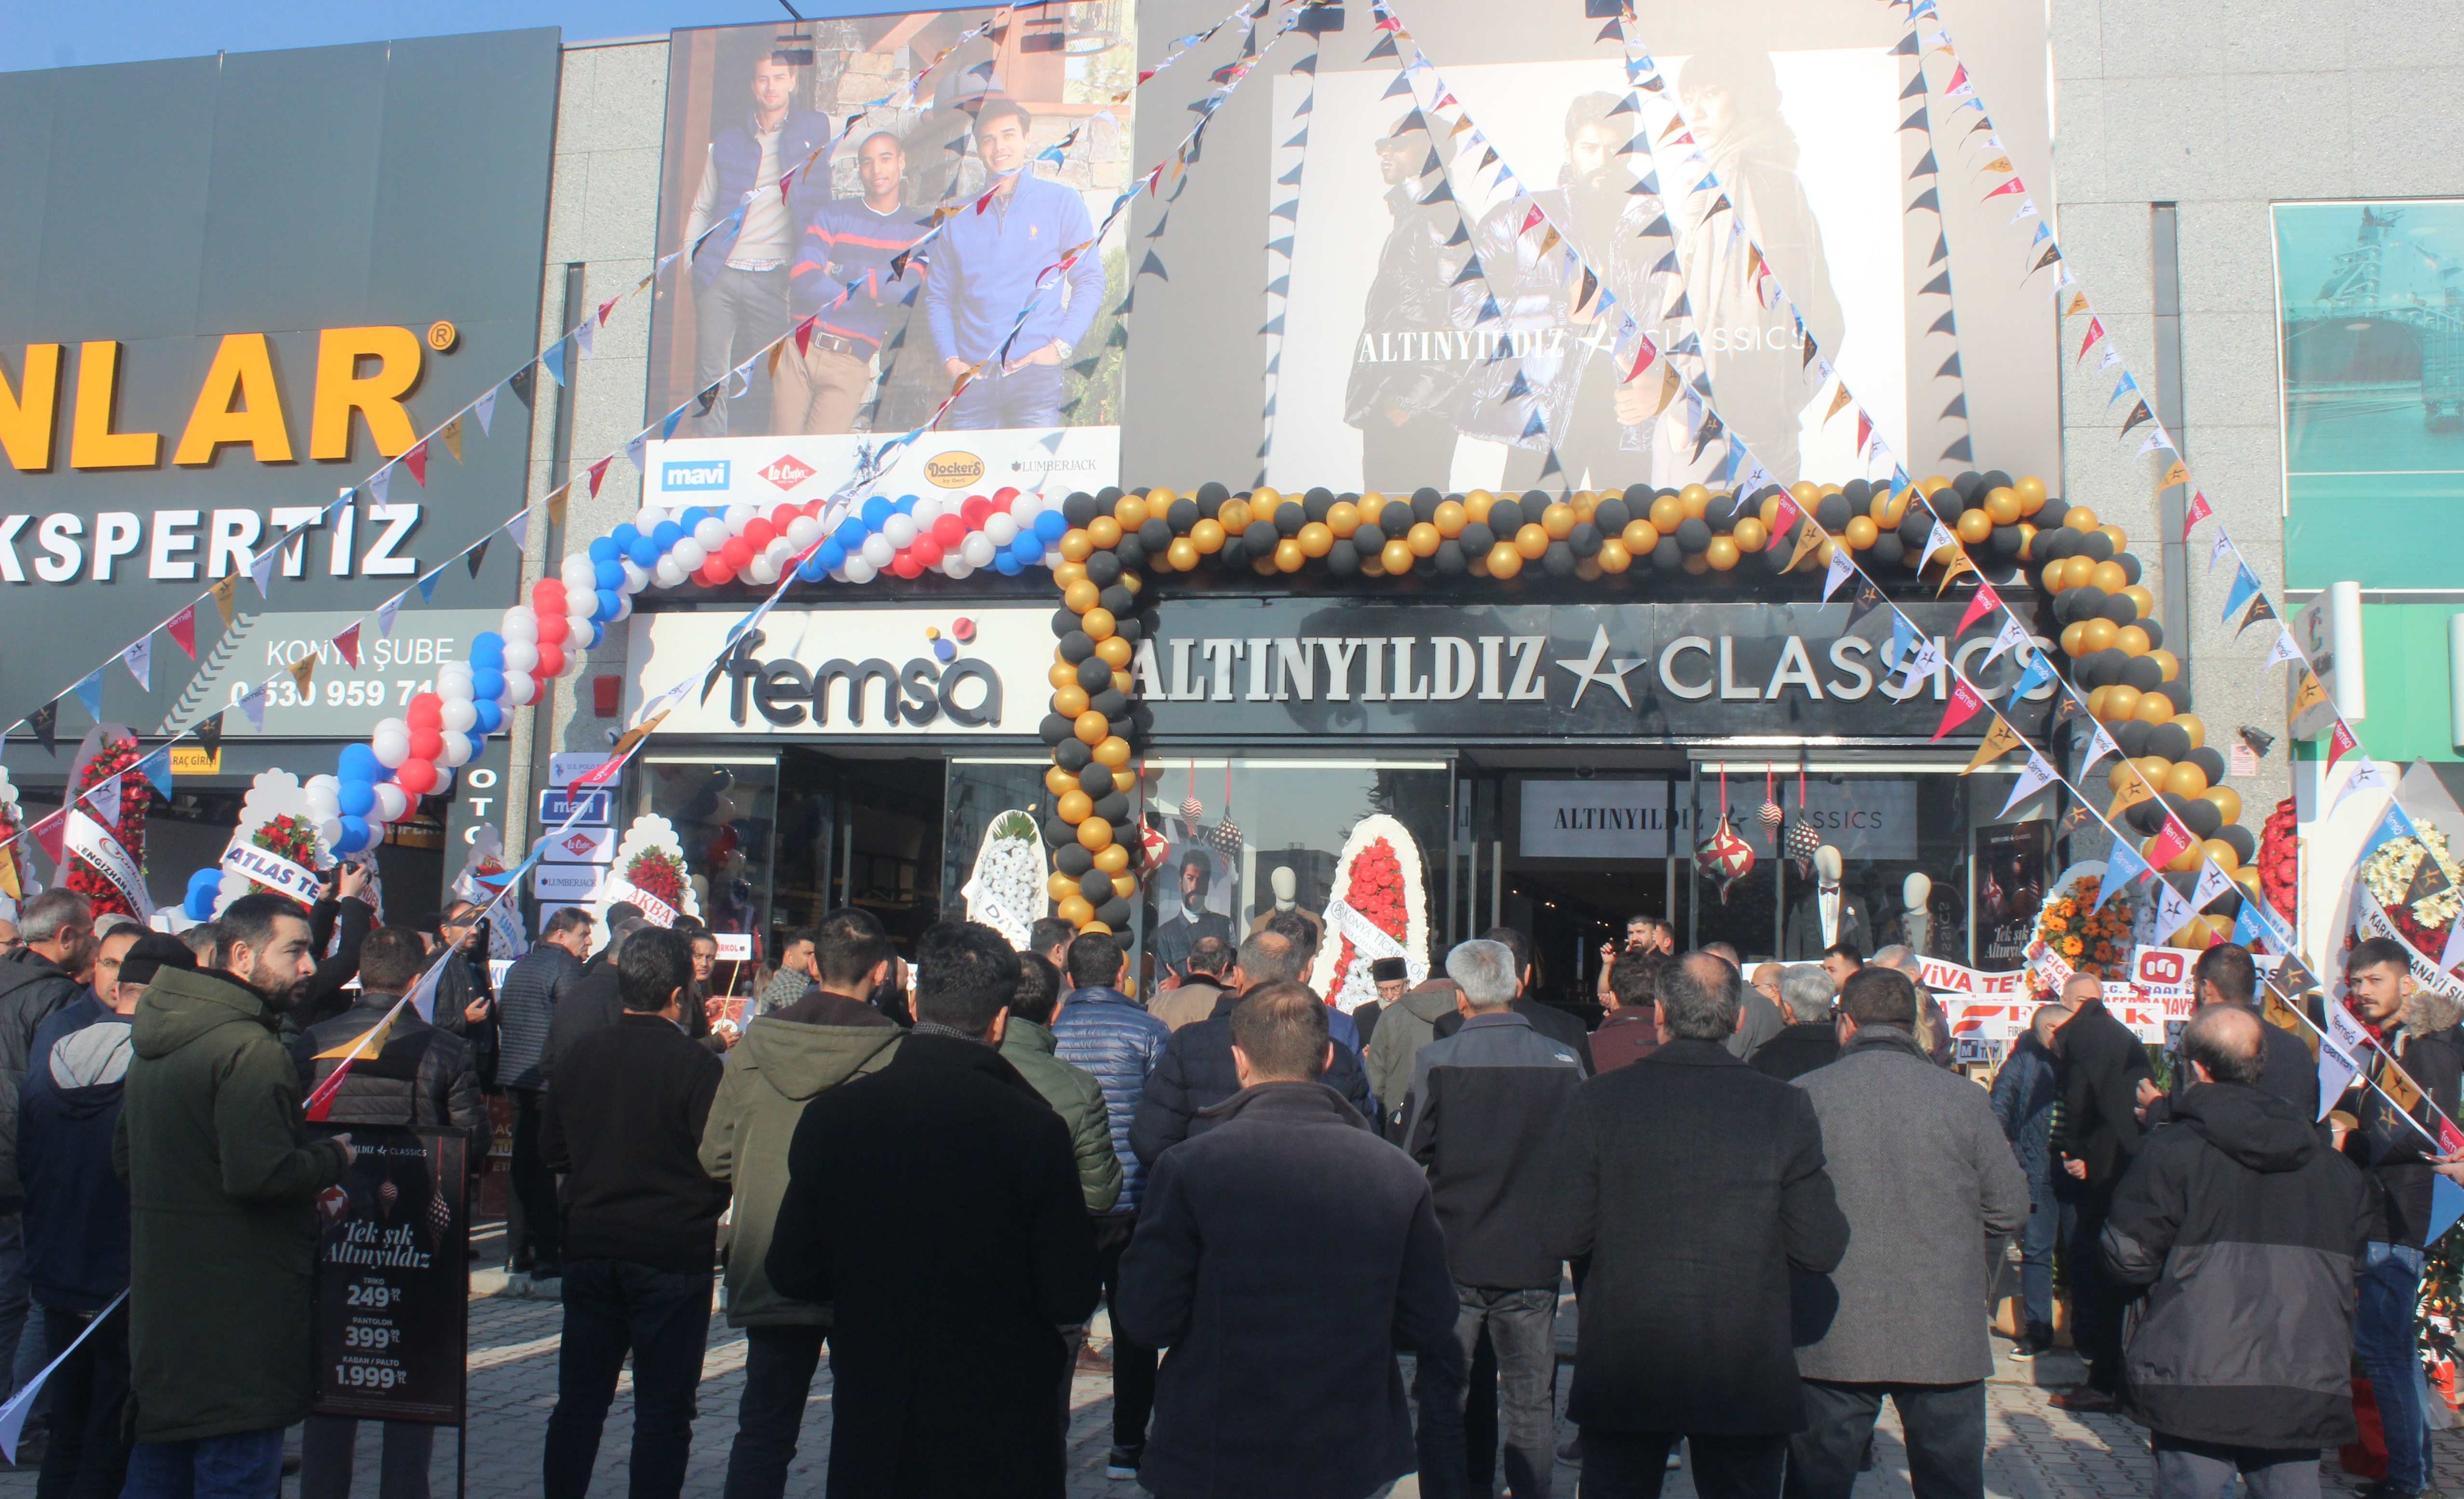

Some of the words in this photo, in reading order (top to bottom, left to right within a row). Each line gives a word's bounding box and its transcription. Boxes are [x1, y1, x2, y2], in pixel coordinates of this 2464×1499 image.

[1357, 327, 1565, 363] ALTINYILDIZ
[668, 463, 725, 485] mavi
[768, 465, 781, 481] Lee
[781, 465, 808, 482] Cooper
[1023, 459, 1097, 472] LUMBERJACK
[373, 638, 454, 671] ŞUBE
[725, 629, 1003, 726] femsa
[1126, 635, 1546, 702] ALTINYILDIZ
[1658, 635, 2059, 701] CLASSICS
[327, 681, 385, 707] 959
[171, 756, 189, 767] RAÇ
[227, 847, 296, 884] ATLAS
[548, 878, 597, 887] LUMBERJACK
[1343, 908, 1373, 937] KONYA
[2333, 1014, 2356, 1045] femsa
[390, 1148, 427, 1157] CLASSICS
[2440, 1130, 2458, 1154] fem
[344, 1219, 378, 1243] Tek
[383, 1223, 414, 1248] şık
[322, 1242, 431, 1269] Altınyıldız
[347, 1285, 390, 1307] 249
[352, 1317, 393, 1325] PANTOLON
[345, 1325, 390, 1349] 399
[343, 1356, 370, 1365] KABAN
[376, 1358, 400, 1367] PALTO
[336, 1365, 396, 1389] 1.999
